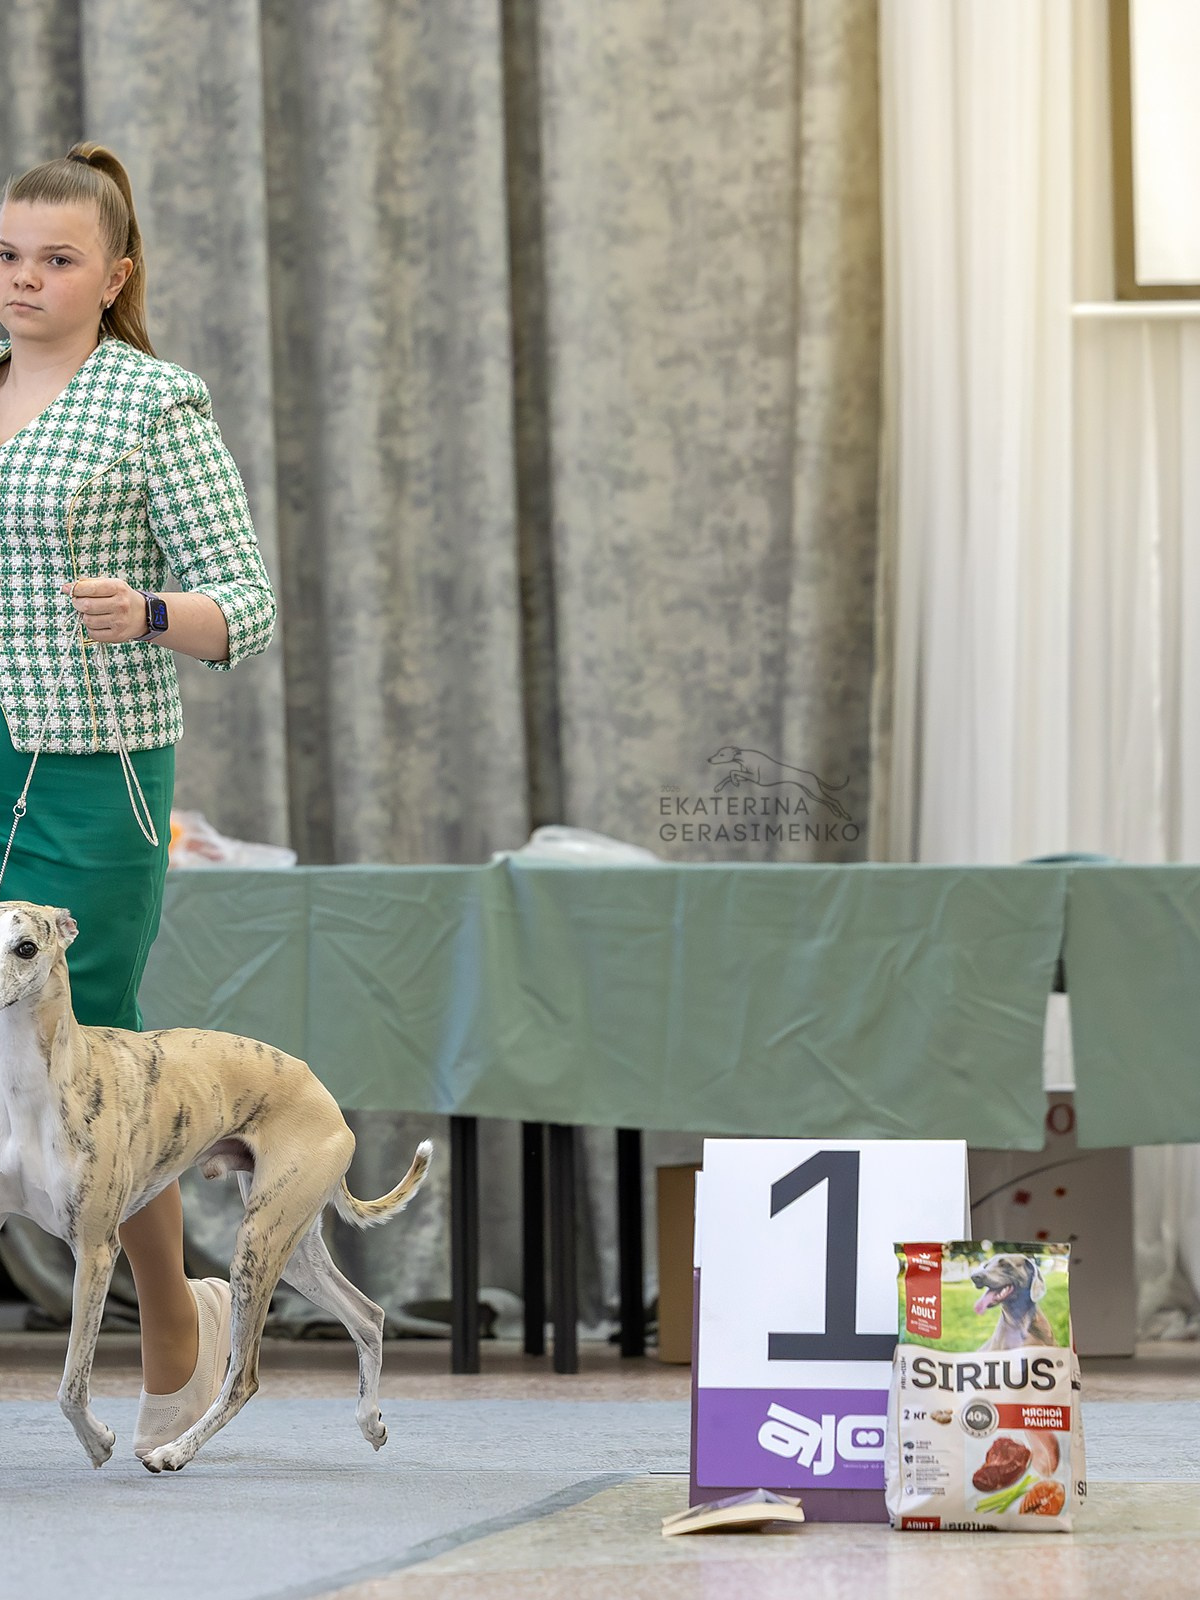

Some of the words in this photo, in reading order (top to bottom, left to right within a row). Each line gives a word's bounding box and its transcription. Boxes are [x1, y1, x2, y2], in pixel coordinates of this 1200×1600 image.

[768, 1151, 898, 1361] 1
[911, 1304, 937, 1320] ADULT
[912, 1357, 1056, 1392] SIRIUS
[904, 1409, 910, 1420] 2
[967, 1410, 990, 1424] 40%
[1022, 1406, 1062, 1418] МЯСНОЙ
[1024, 1416, 1063, 1428] РАЦИОН
